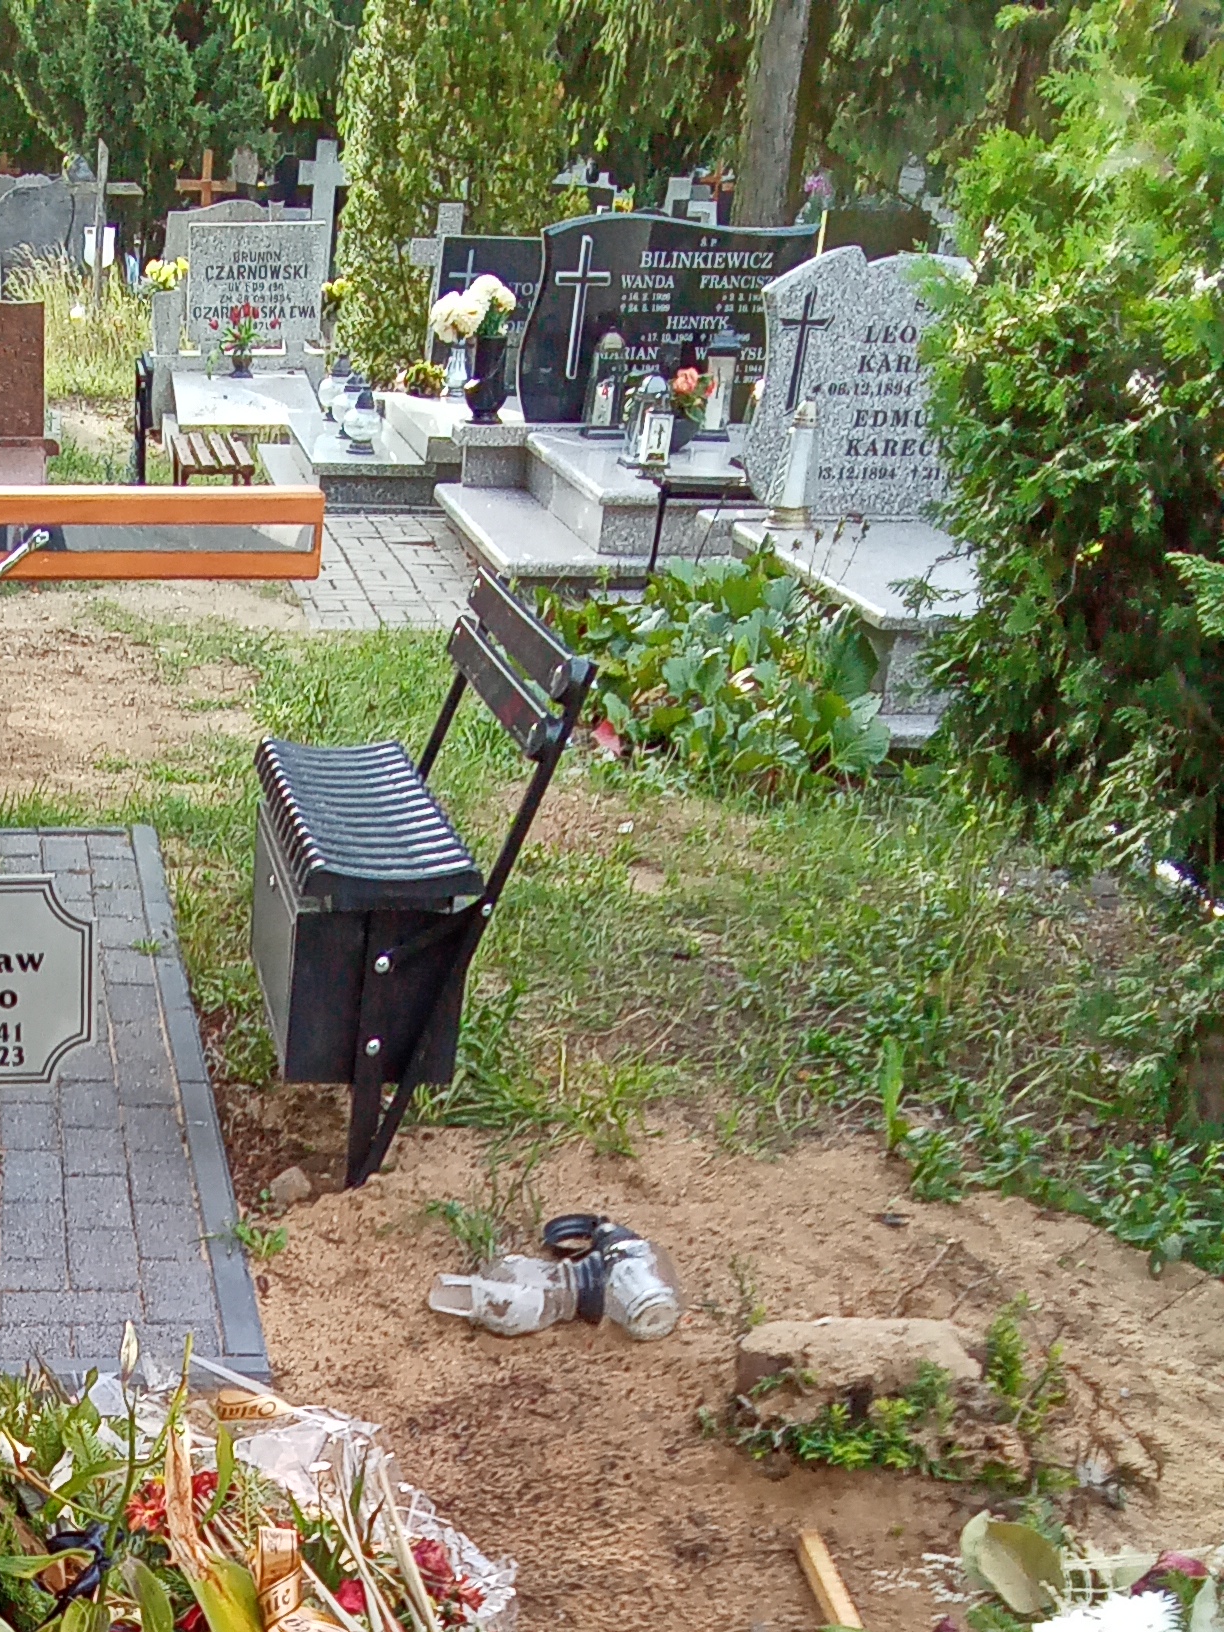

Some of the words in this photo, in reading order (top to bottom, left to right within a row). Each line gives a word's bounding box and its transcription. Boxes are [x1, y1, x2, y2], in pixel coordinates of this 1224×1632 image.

[639, 251, 775, 269] BILINKIEWICZ
[204, 264, 308, 281] CZARNOWSKI
[621, 275, 675, 289] WANDA
[665, 315, 730, 330] HENRYK
[863, 325, 923, 345] LEO
